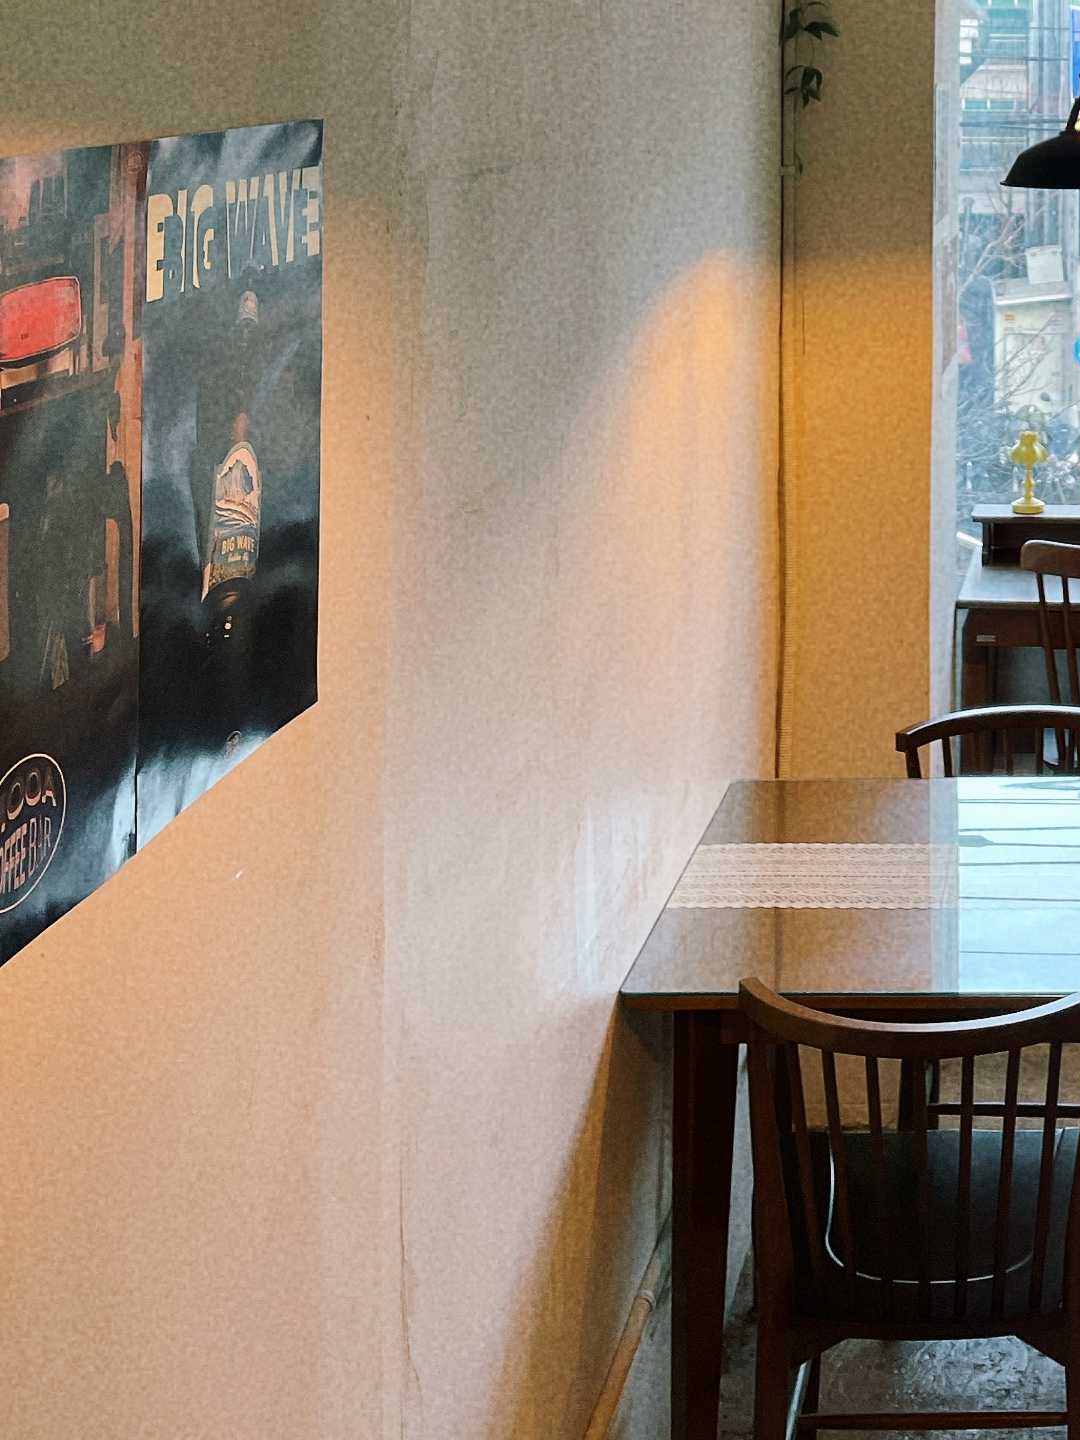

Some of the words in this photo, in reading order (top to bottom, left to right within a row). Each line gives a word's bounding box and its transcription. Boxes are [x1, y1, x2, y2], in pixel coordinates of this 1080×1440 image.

[146, 185, 214, 302] BIG
[226, 165, 320, 279] WAVE
[221, 536, 235, 555] BIG
[0, 767, 57, 834] OOA
